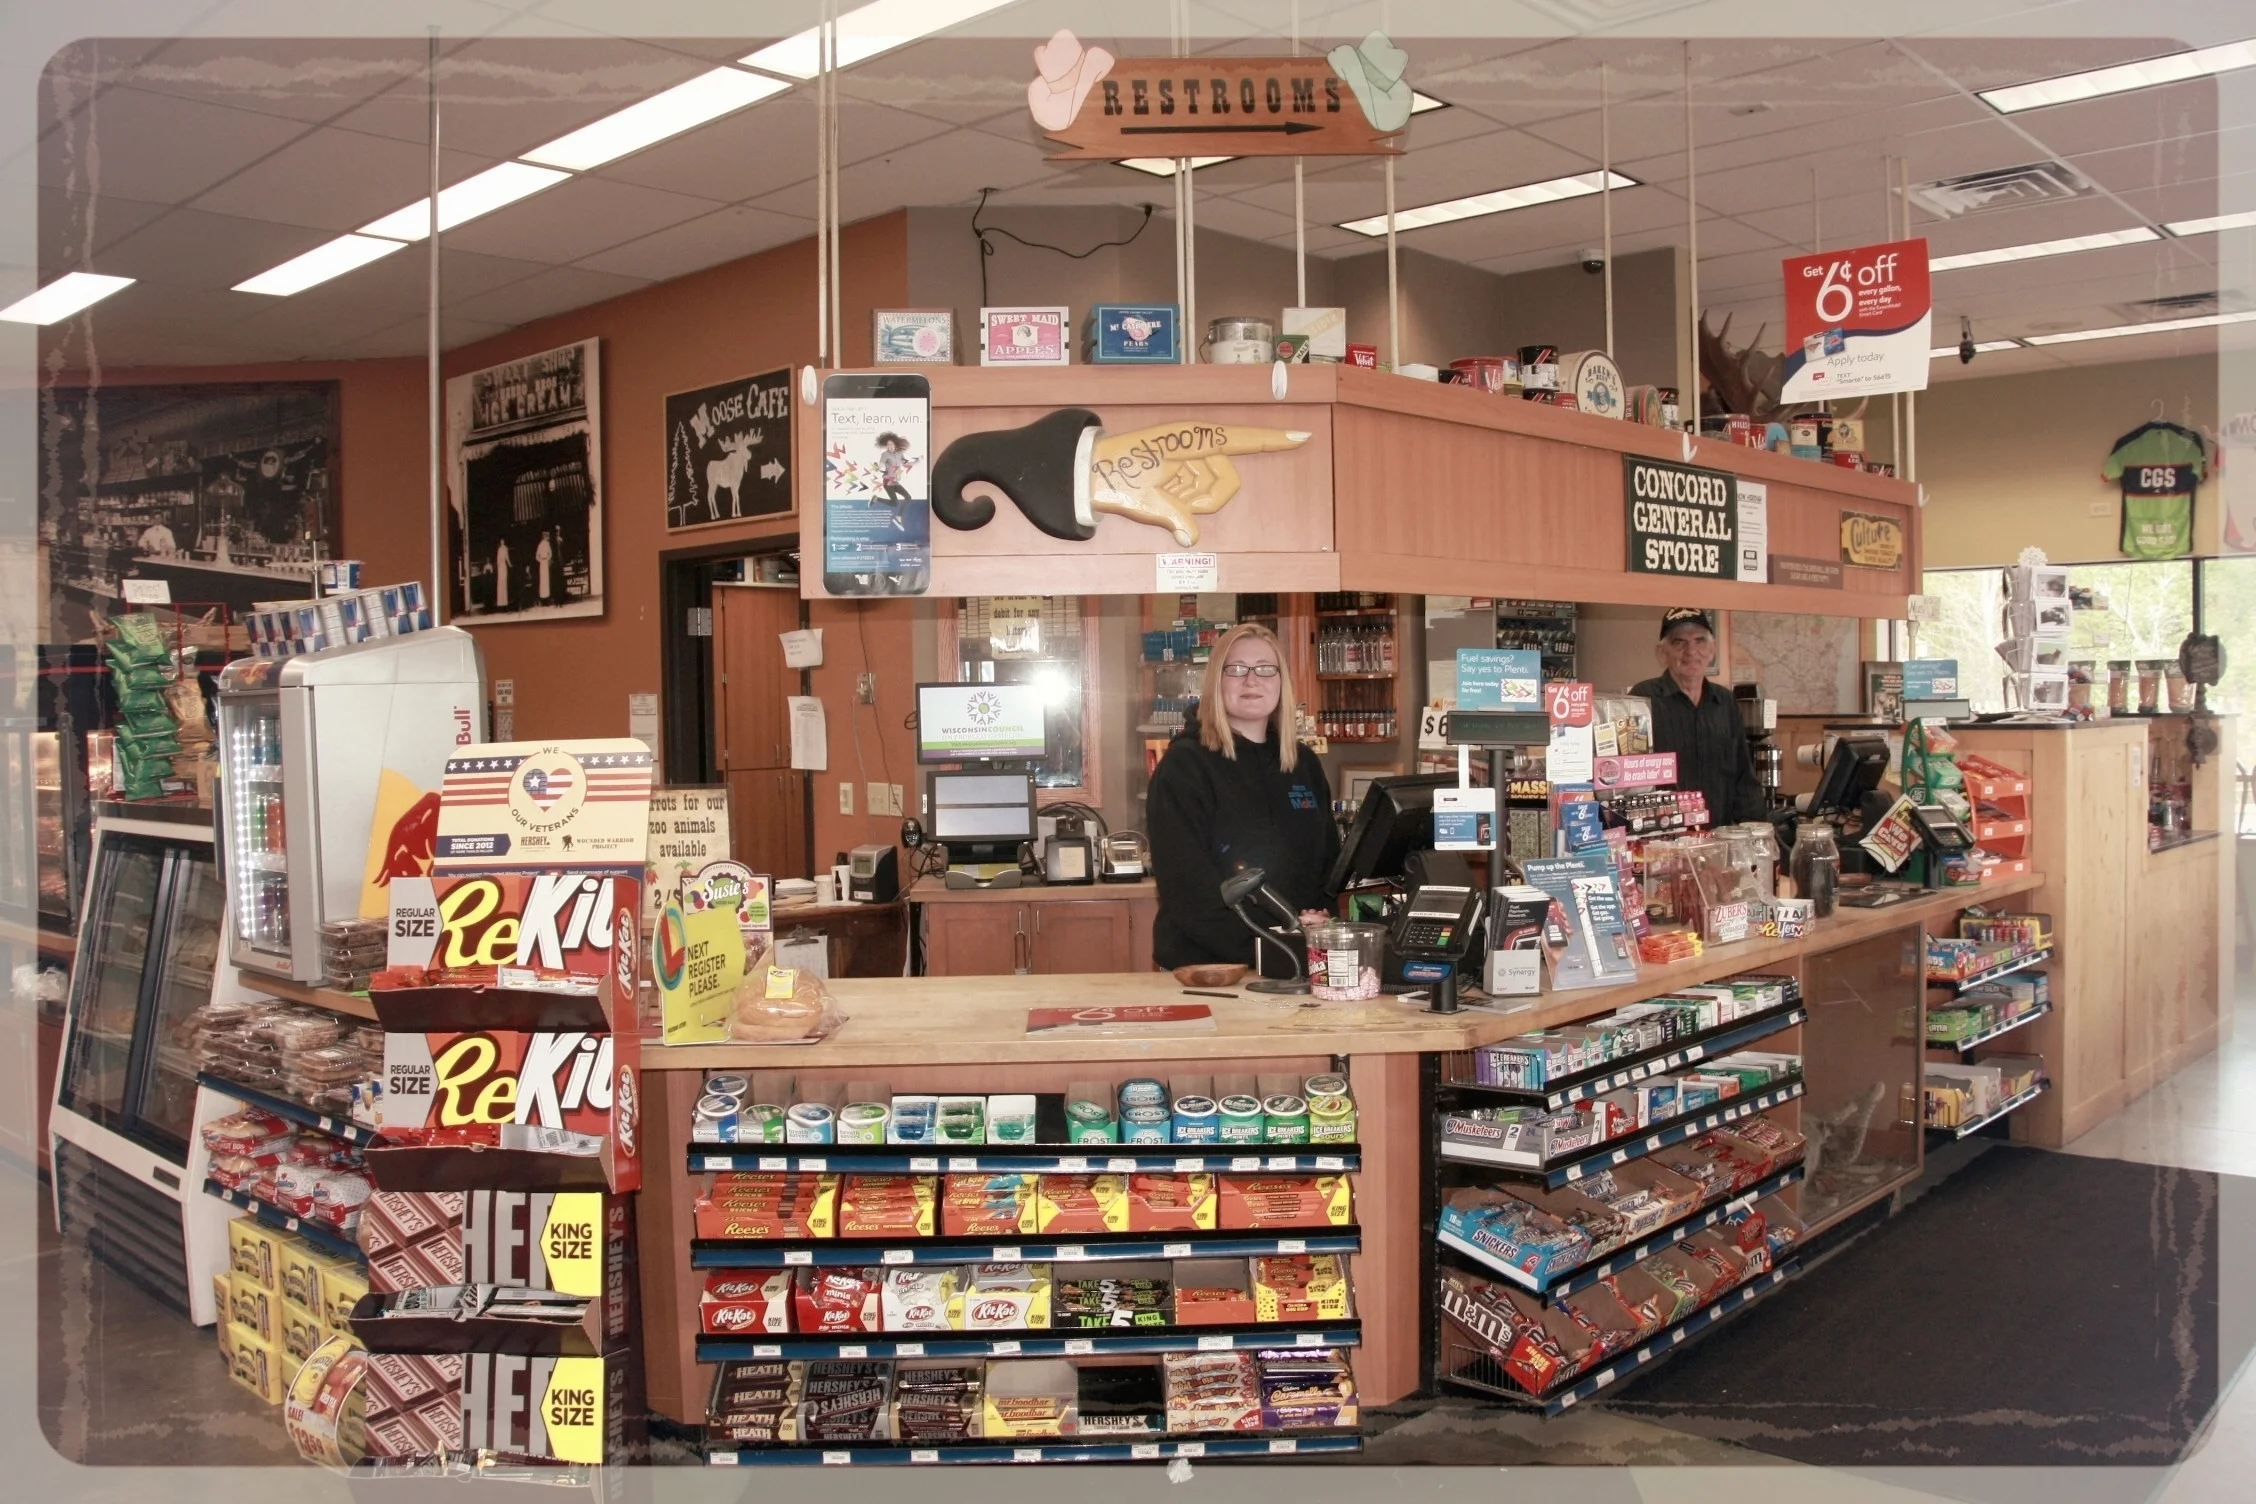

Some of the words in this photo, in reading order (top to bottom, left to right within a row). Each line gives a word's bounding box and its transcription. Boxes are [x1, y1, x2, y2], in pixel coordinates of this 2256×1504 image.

[1102, 77, 1341, 116] RESTROOMS
[1803, 266, 1824, 278] Get
[1816, 260, 1853, 323] 6¢
[1857, 252, 1899, 285] off
[1858, 287, 1877, 296] every
[1858, 297, 1877, 306] every
[1879, 295, 1892, 305] day
[882, 316, 947, 325] WATERMELONS
[991, 314, 1026, 327] SWEET
[1031, 313, 1060, 326] MAID
[993, 343, 1056, 356] APPLES
[1354, 353, 1374, 366] Velvet
[1826, 356, 1855, 368] Apply
[1857, 352, 1885, 365] today
[689, 392, 745, 450] MOOSE
[746, 383, 790, 420] CAFE
[831, 412, 860, 426] Text,
[863, 412, 895, 426] learn,
[897, 412, 923, 424] win.
[1091, 426, 1228, 494] Restrooms
[2140, 467, 2176, 488] CGS
[1634, 465, 1727, 508] CONCORD
[1633, 501, 1732, 541] GENERAL
[1850, 517, 1891, 555] Culture
[1162, 557, 1211, 566] WARNING!
[1645, 538, 1720, 574] STORE
[1013, 607, 1024, 618] for
[1461, 654, 1479, 663] Fuel
[1481, 654, 1514, 665] savings?
[1461, 664, 1478, 675] Say
[1479, 666, 1492, 675] yes
[1493, 664, 1502, 674] to
[1504, 664, 1530, 674] Plenti.
[1484, 681, 1499, 689] today
[1571, 686, 1590, 701] off
[455, 710, 472, 745] Bull
[543, 746, 560, 755] WE
[1623, 758, 1640, 769] Hours
[1640, 758, 1645, 768] of
[1645, 757, 1662, 769] energy
[1623, 770, 1631, 781] No
[1631, 769, 1647, 781] crash
[684, 793, 700, 811] for
[706, 794, 725, 811] our
[511, 808, 528, 828] OUR
[529, 807, 580, 833] VETERANS
[649, 820, 668, 835] zoo
[674, 817, 716, 834] animals
[1889, 820, 1907, 839] We
[659, 841, 707, 858] available
[1527, 863, 1545, 873] Pump
[1546, 864, 1555, 872] up
[702, 878, 749, 901] Susie's
[395, 908, 436, 918] REGULAR
[1716, 901, 1748, 923] ZUBER'S
[394, 919, 436, 938] SIZE
[439, 879, 521, 968] Re
[617, 913, 634, 992] KitKat
[687, 940, 710, 962] NEXT
[688, 953, 727, 980] REGISTER
[1508, 967, 1536, 978] Synergy
[688, 973, 721, 999] PLEASE.
[390, 1064, 431, 1075] REGULAR
[389, 1076, 431, 1095] SIZE
[434, 1036, 518, 1127] Re
[618, 1070, 634, 1150] KitKat
[1071, 1102, 1104, 1118] FROST
[1177, 1127, 1187, 1135] ICE
[1187, 1126, 1215, 1135] BREAKERS
[1221, 1127, 1231, 1135] ICE
[1231, 1127, 1260, 1135] BREAKERS
[1267, 1126, 1277, 1135] ICE
[1278, 1126, 1305, 1135] BREAKERS
[1509, 1126, 1518, 1136] 2
[1077, 1136, 1112, 1144] FROST
[1247, 1182, 1294, 1192] Reese's
[374, 1190, 426, 1233] HERSHEY'S
[723, 1198, 768, 1209] Reese's
[550, 1223, 592, 1240] KING
[724, 1222, 770, 1236] Reese's
[844, 1220, 880, 1232] Reese's
[549, 1241, 593, 1259] SIZE
[1473, 1228, 1520, 1259] SNICKERS
[608, 1206, 625, 1336] HERSHEY'S
[716, 1282, 755, 1294] KitKat
[825, 1289, 852, 1300] minis
[715, 1307, 753, 1325] KitKat
[978, 1301, 1016, 1320] KitKat
[1078, 1315, 1110, 1327] TAKE
[1110, 1309, 1133, 1327] 5
[1137, 1313, 1159, 1322] KING
[736, 1363, 784, 1379] HEATH
[904, 1369, 959, 1383] HERSHEY'S
[551, 1388, 595, 1406] KING
[733, 1389, 782, 1404] HEATH
[550, 1407, 595, 1426] SIZE
[1083, 1415, 1140, 1427] HERSHEY'S
[732, 1427, 772, 1440] HEATH
